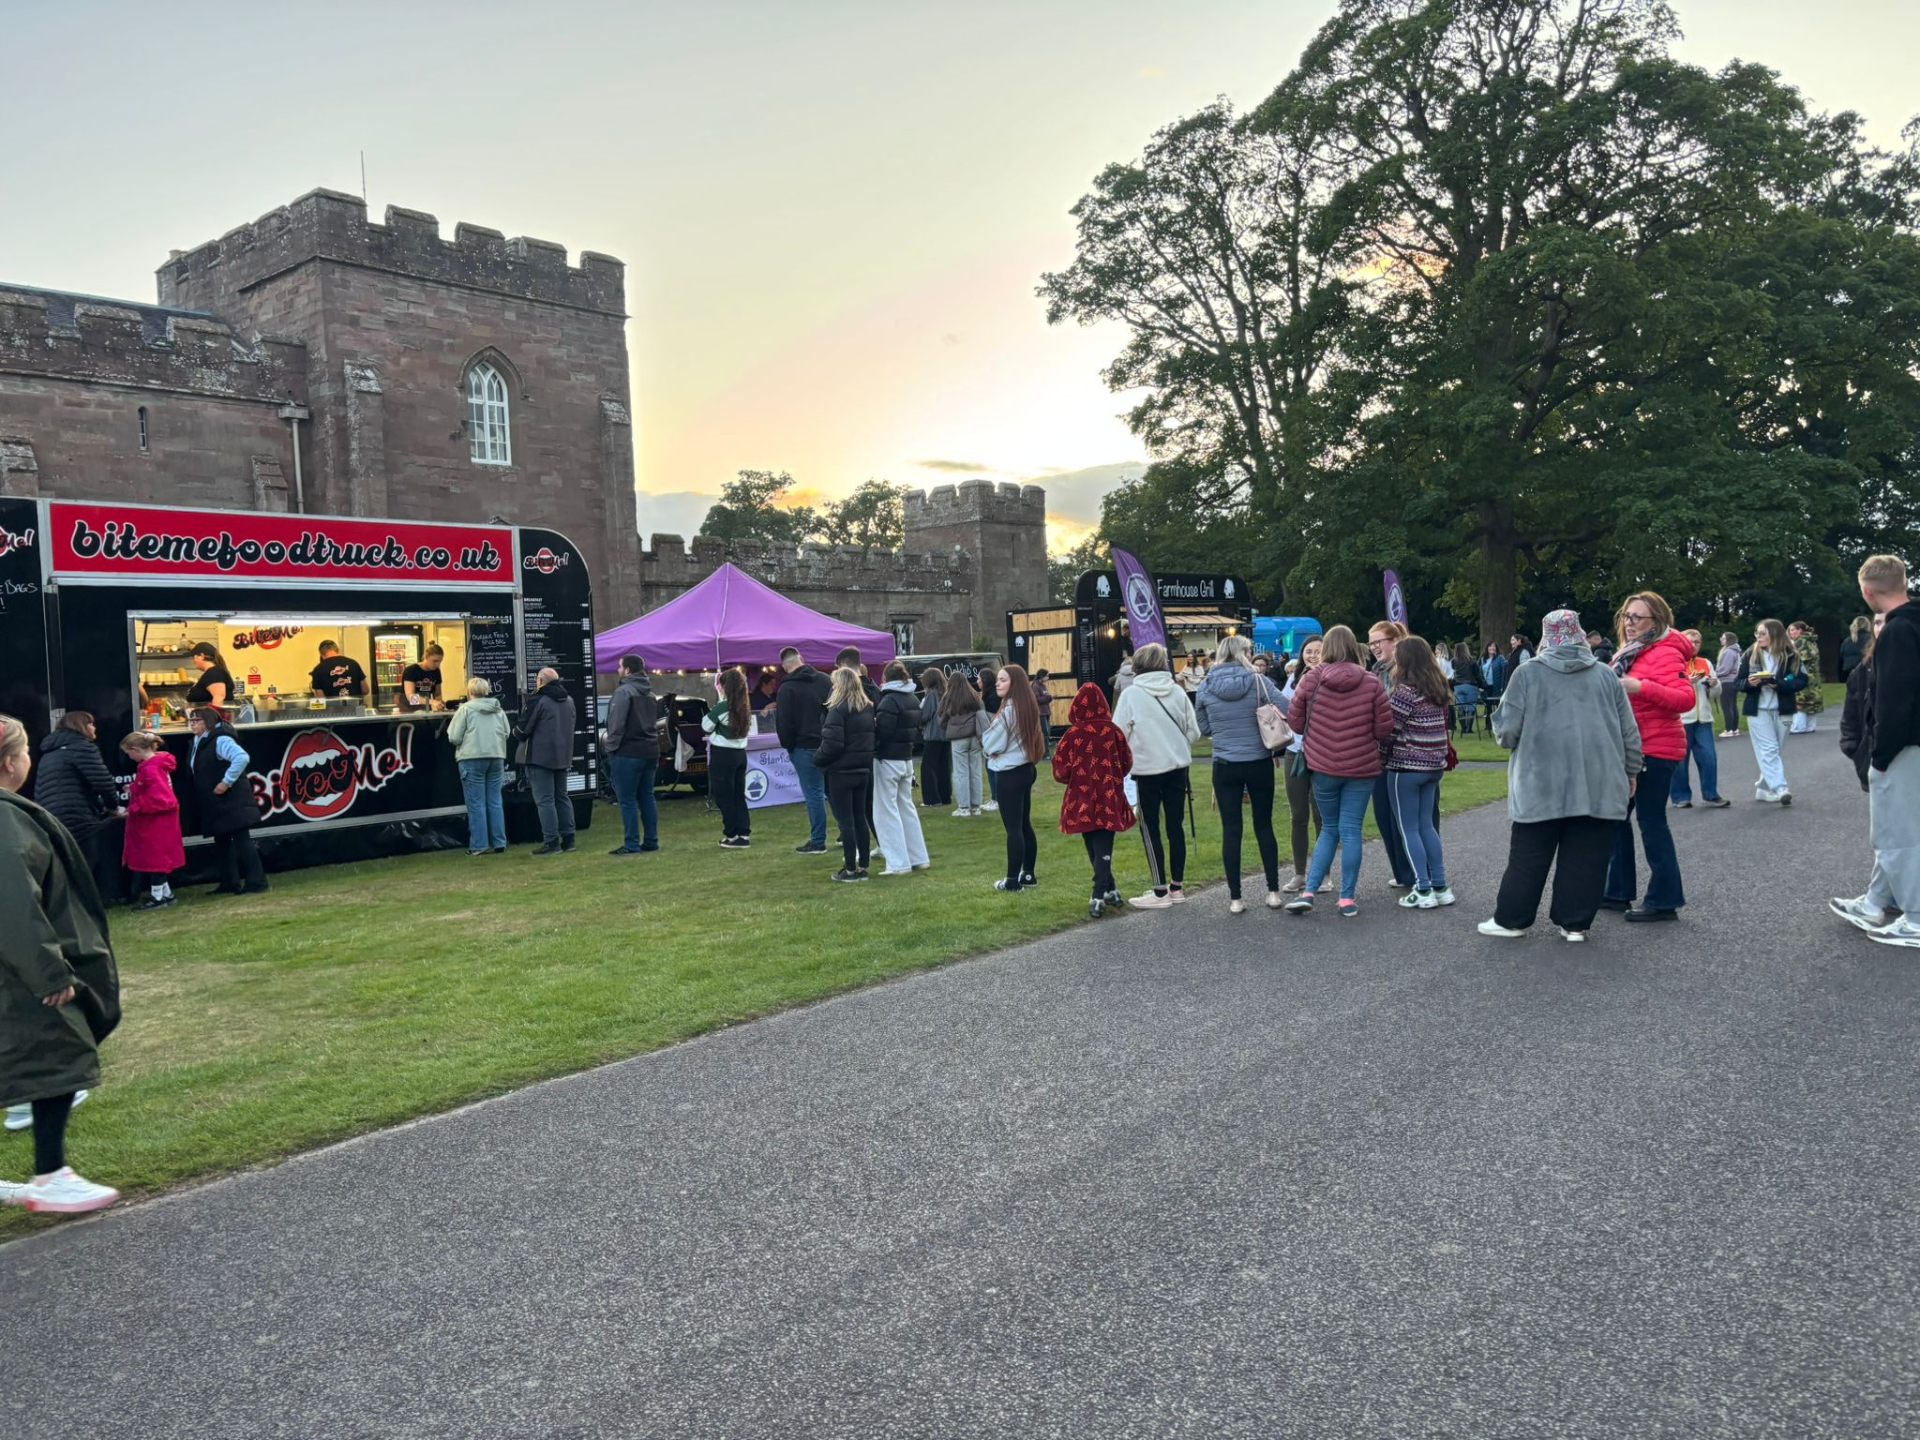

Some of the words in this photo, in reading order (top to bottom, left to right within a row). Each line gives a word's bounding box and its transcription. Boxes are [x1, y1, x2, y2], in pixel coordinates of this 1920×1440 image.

[71, 519, 501, 571] bitemefoodtruck.co.uk
[1157, 579, 1198, 597] Farmhouse
[1200, 579, 1215, 598] Grill
